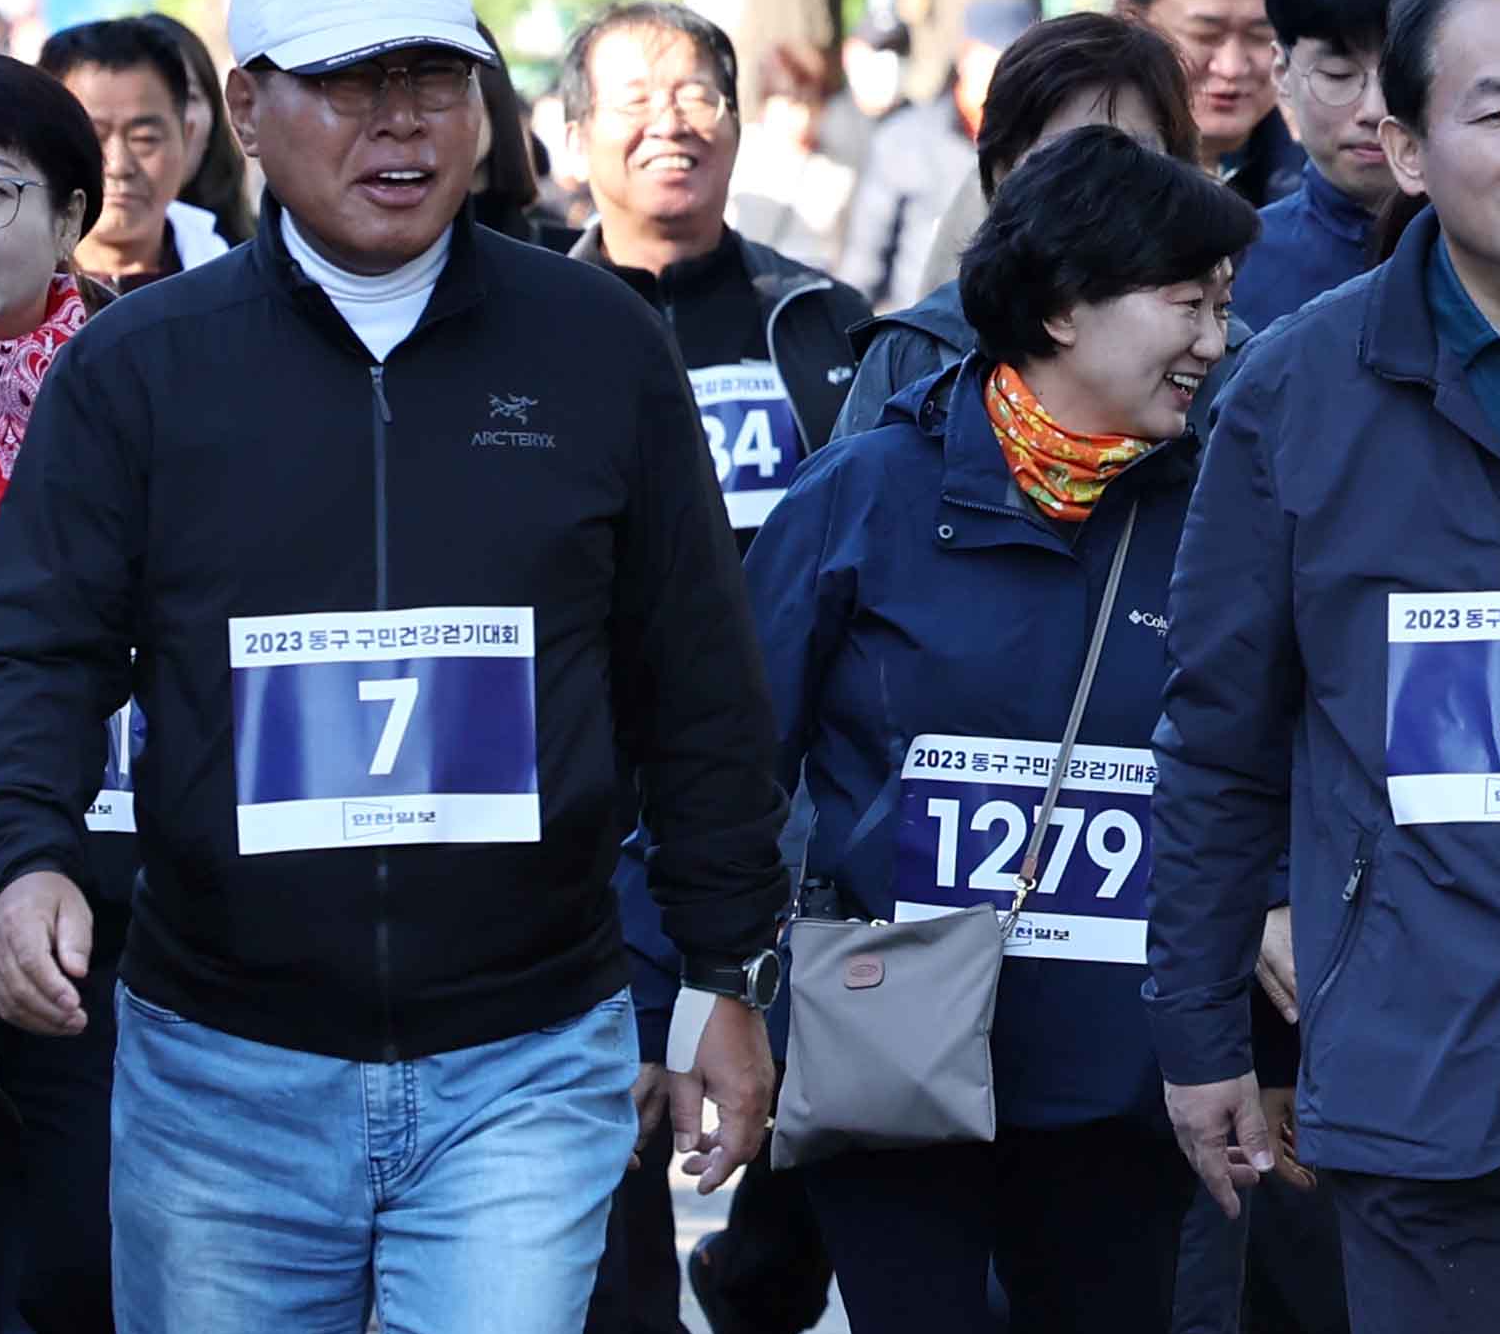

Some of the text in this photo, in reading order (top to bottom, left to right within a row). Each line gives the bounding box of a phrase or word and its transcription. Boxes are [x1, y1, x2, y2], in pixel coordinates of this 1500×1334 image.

[1405, 609, 1460, 629] 2023
[245, 624, 519, 654] 2023 동구 구민건강걷기대회
[358, 677, 419, 775] 7
[914, 749, 966, 769] 2023
[971, 753, 1009, 772] 동구
[927, 797, 1143, 899] 1279
[1014, 927, 1070, 940] 천일보
